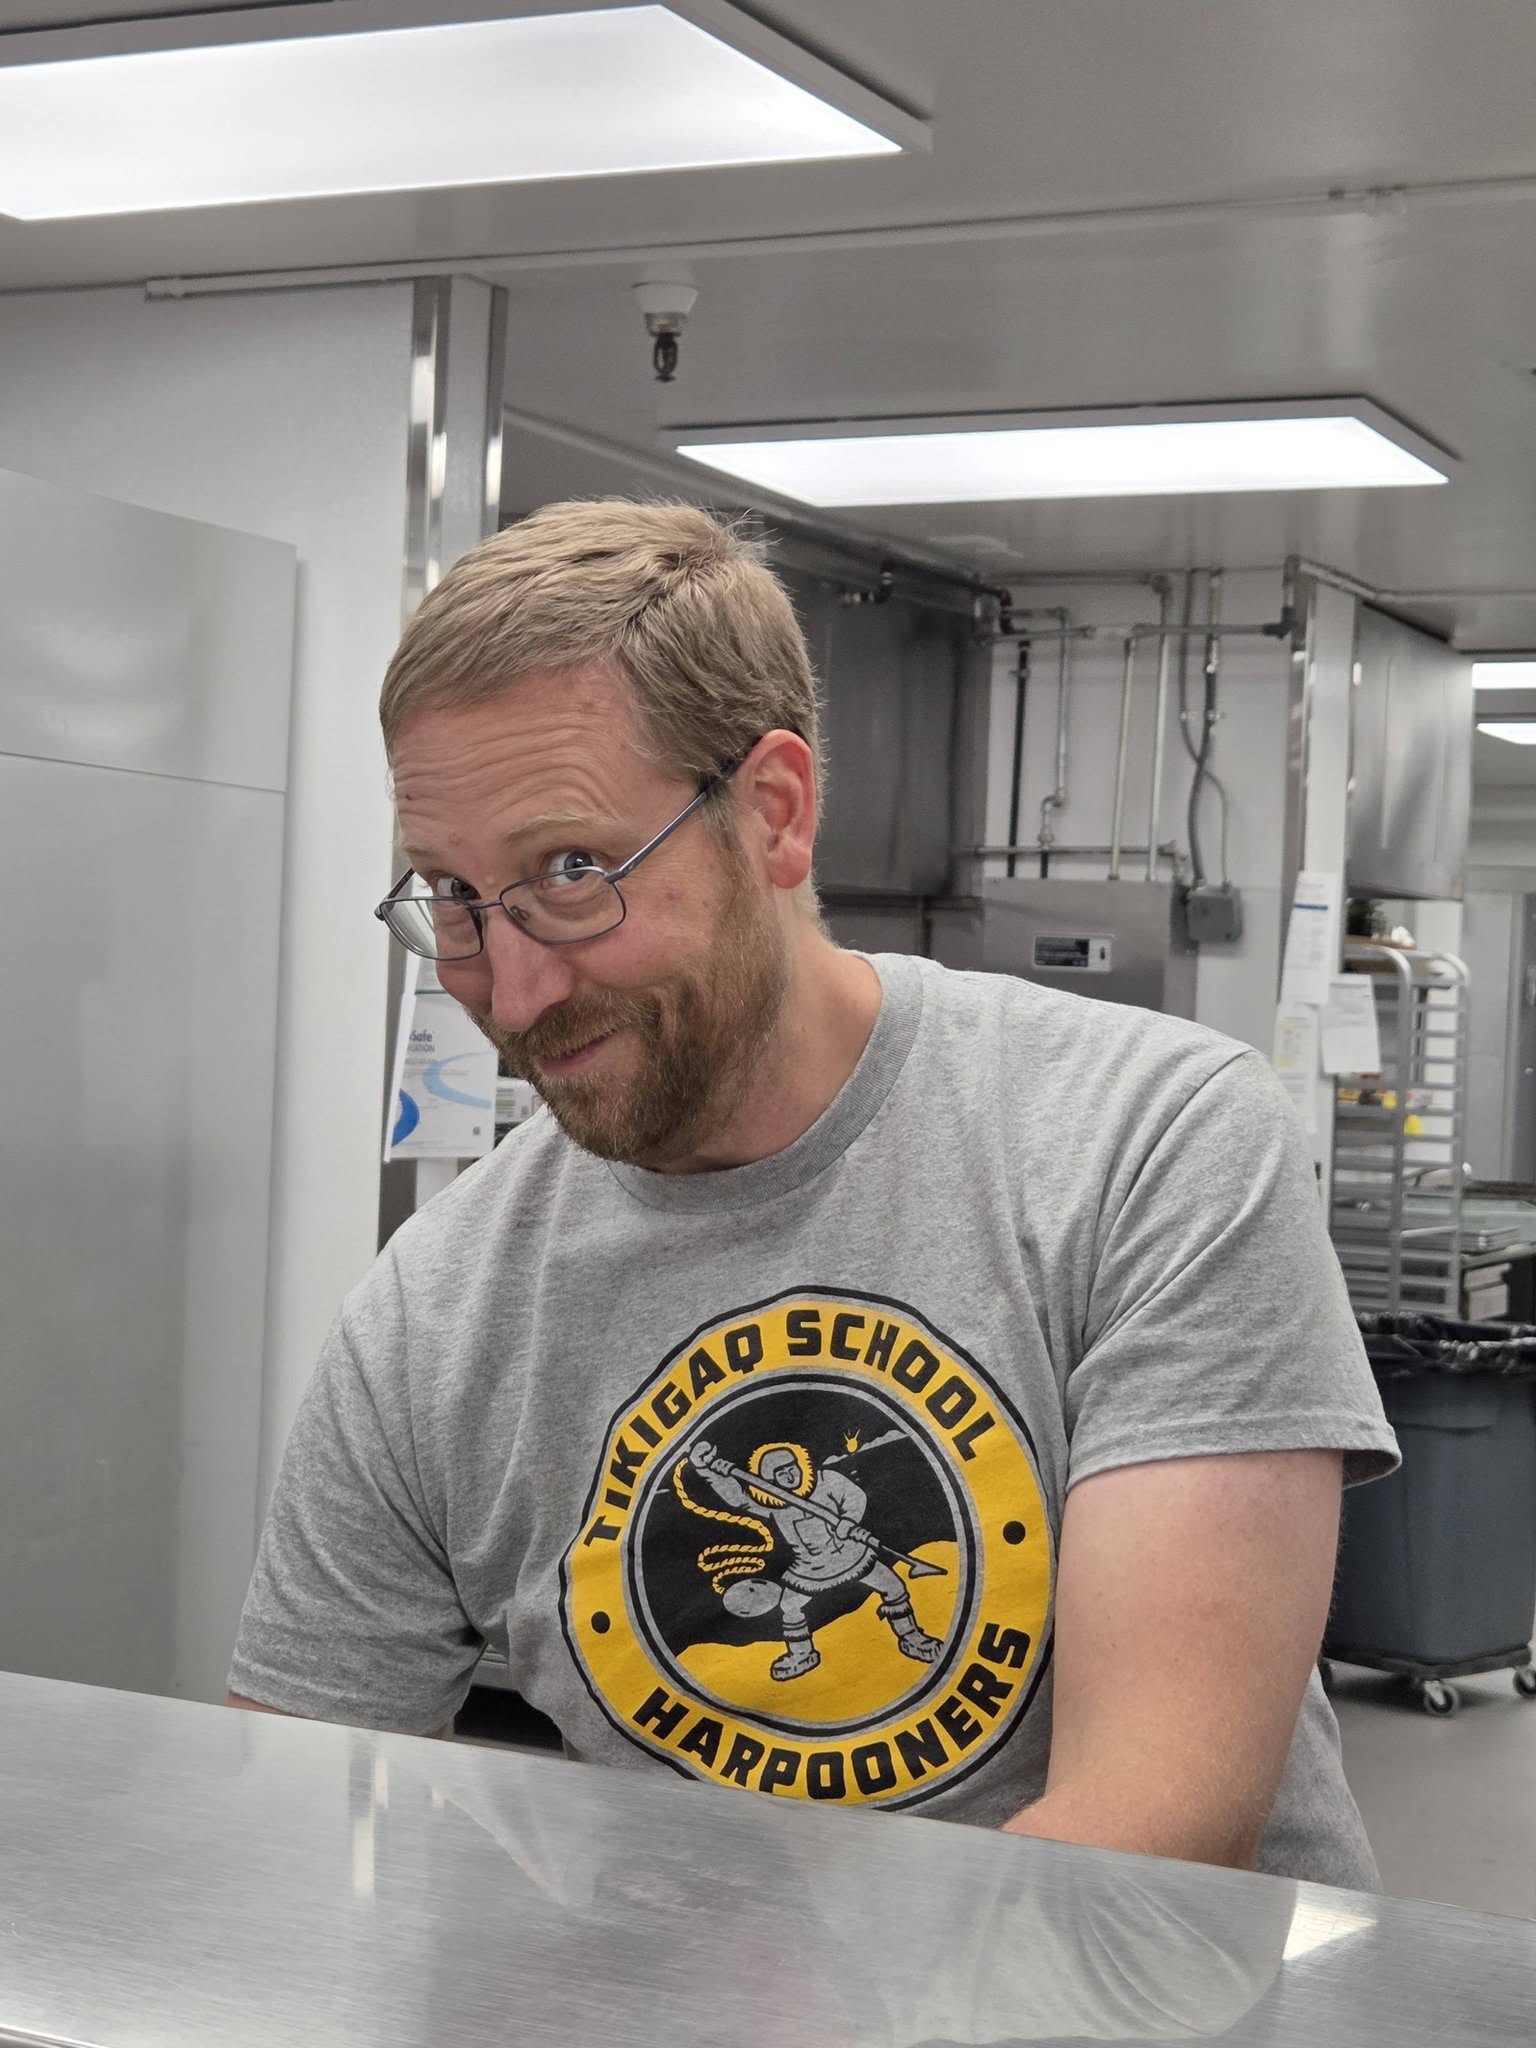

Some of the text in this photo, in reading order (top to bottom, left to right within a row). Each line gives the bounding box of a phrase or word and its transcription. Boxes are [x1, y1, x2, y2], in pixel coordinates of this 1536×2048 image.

[584, 1309, 996, 1548] TIKIGAQ SCHOOL
[632, 1622, 1031, 1801] HARPOONERS
